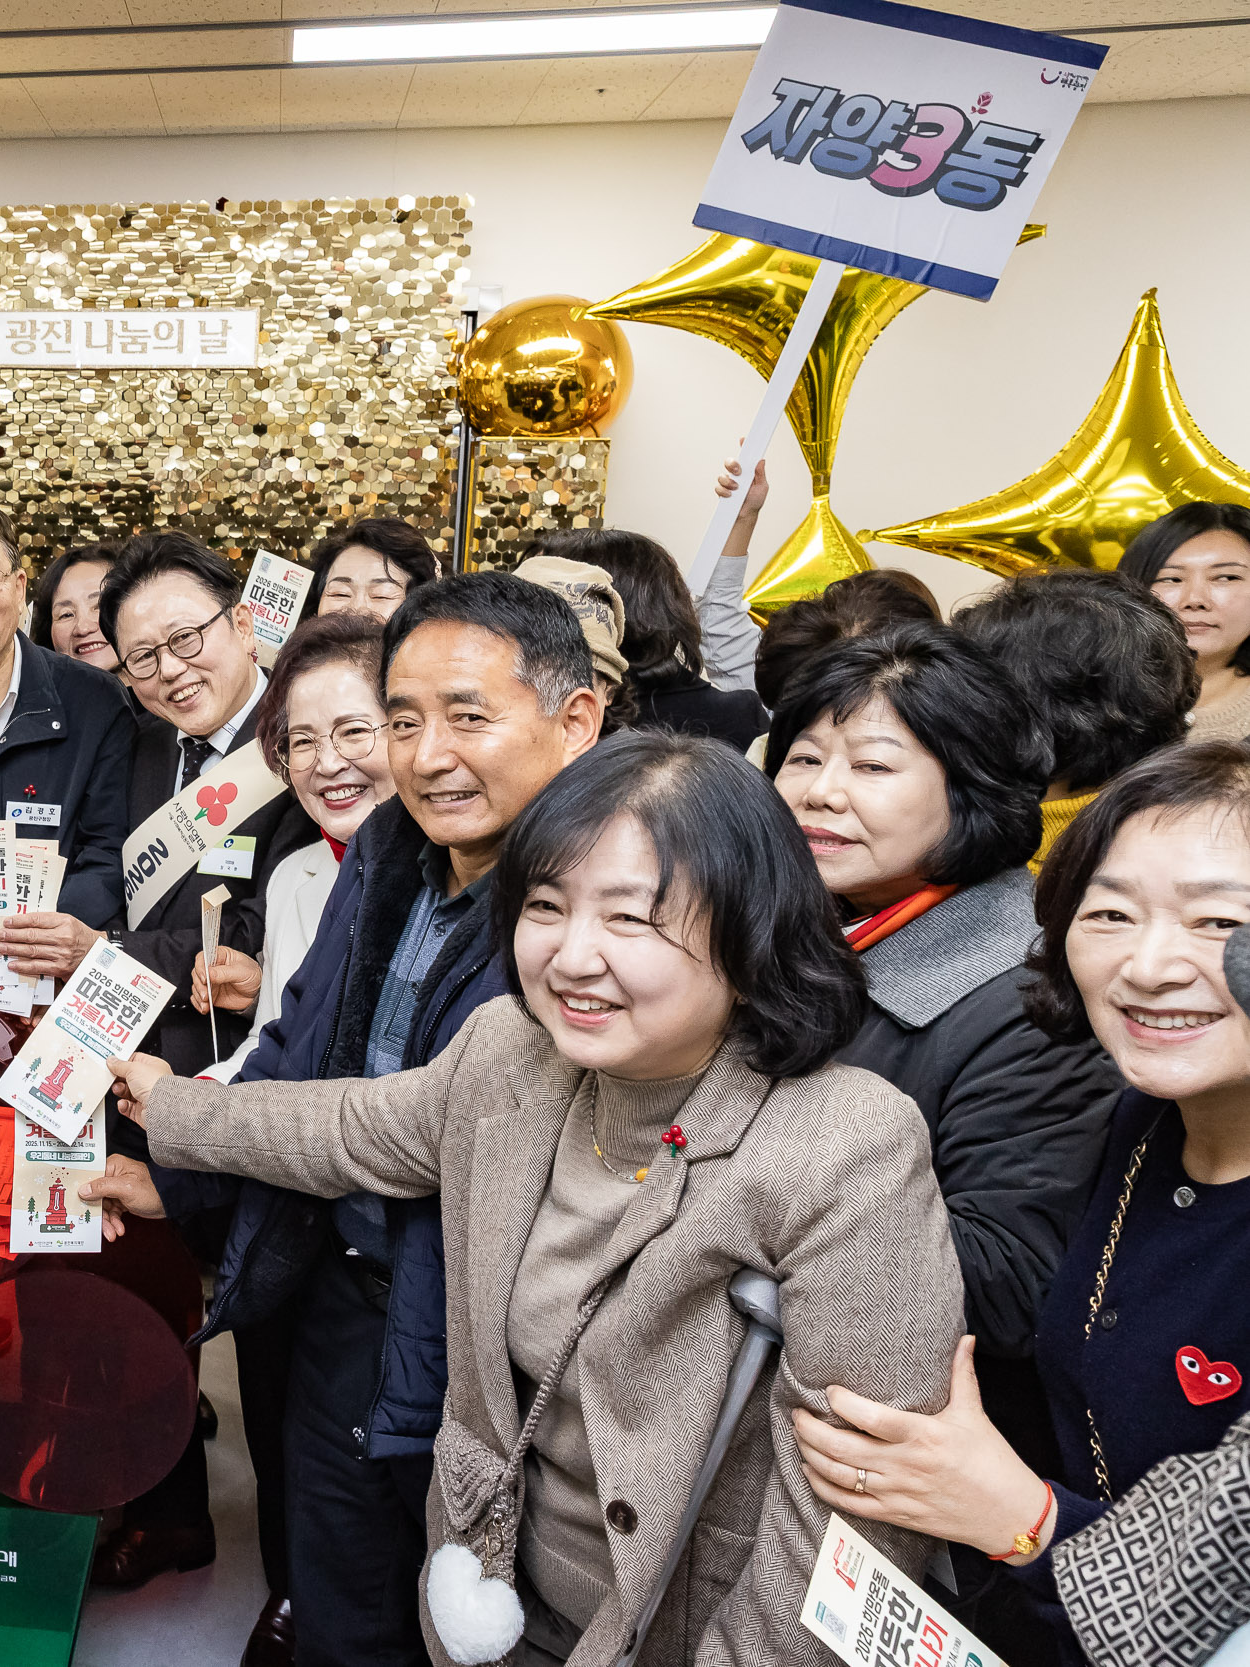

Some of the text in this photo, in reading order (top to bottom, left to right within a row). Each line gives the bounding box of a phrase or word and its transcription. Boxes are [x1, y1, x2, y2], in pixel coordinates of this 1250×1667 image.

[741, 77, 1045, 211] 자양3동
[6, 319, 232, 355] 광진 나눔의 날
[250, 584, 295, 616] 따뜻한
[255, 575, 271, 587] 2026
[248, 600, 289, 628] 겨울나기
[75, 977, 142, 1030] 따뜻한
[88, 967, 112, 988] 2026
[113, 983, 149, 1013] 희망온돌
[66, 994, 130, 1044] 겨울나기
[854, 1568, 890, 1663] 2026 희망온돌
